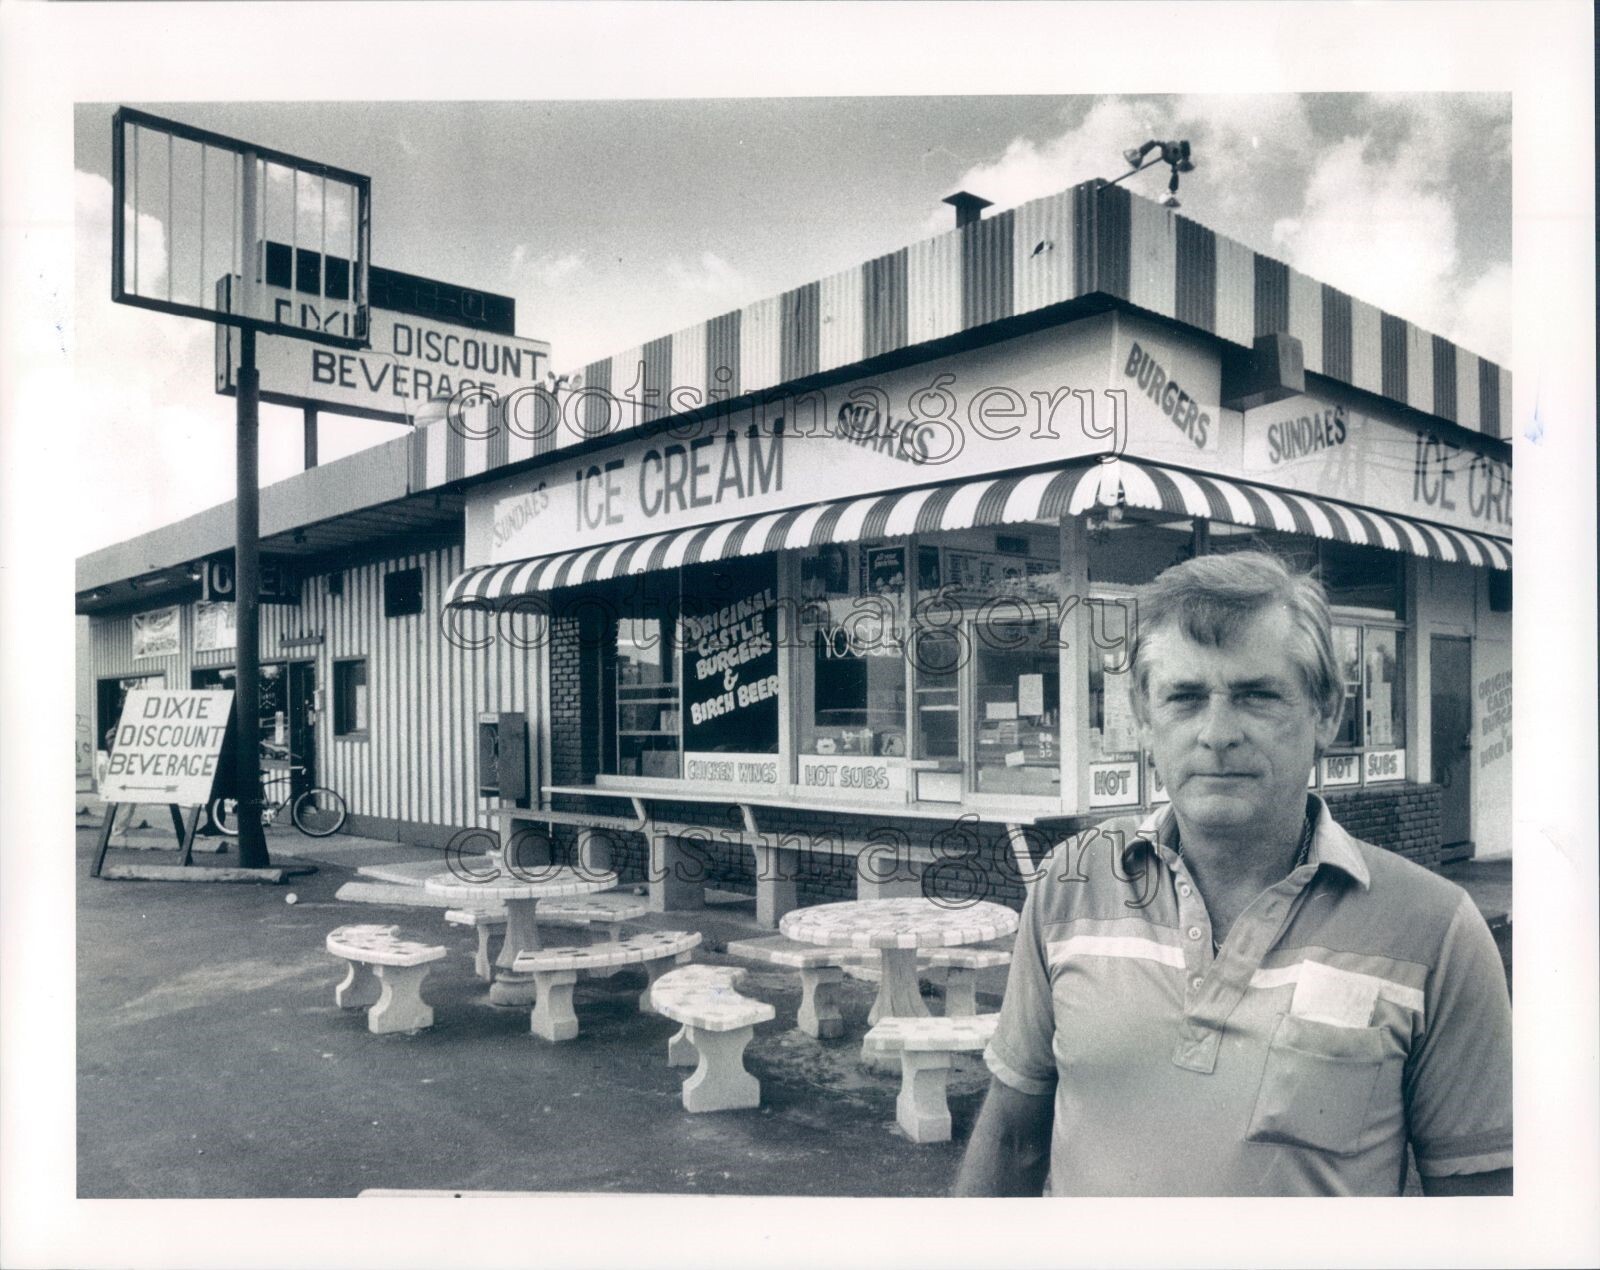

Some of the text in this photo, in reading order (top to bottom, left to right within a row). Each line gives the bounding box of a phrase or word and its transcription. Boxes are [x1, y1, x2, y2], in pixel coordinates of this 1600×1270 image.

[274, 297, 548, 381] DIXI DISCOUNT
[1124, 341, 1211, 450] BURGERS
[835, 401, 935, 466] SHAKES
[1267, 406, 1347, 464] SUNDAES
[576, 416, 786, 532] ICE CREAM
[1413, 431, 1456, 511] ICE
[493, 482, 549, 548] SUNDAES
[687, 588, 776, 640] ORIGINAL
[698, 613, 765, 657] CASTLE
[695, 632, 772, 680] BURGERS
[723, 668, 739, 691] &
[143, 697, 212, 719] DIXIE
[690, 675, 779, 725] BIRCH BEER
[118, 724, 226, 748] DISCOUNT
[108, 752, 219, 777] BEVERAGE
[687, 759, 777, 784] CHICKEN WINGS
[805, 764, 889, 789] HOT SUBS
[1094, 770, 1131, 796] HOT
[1327, 753, 1398, 779] HOT SUBS
